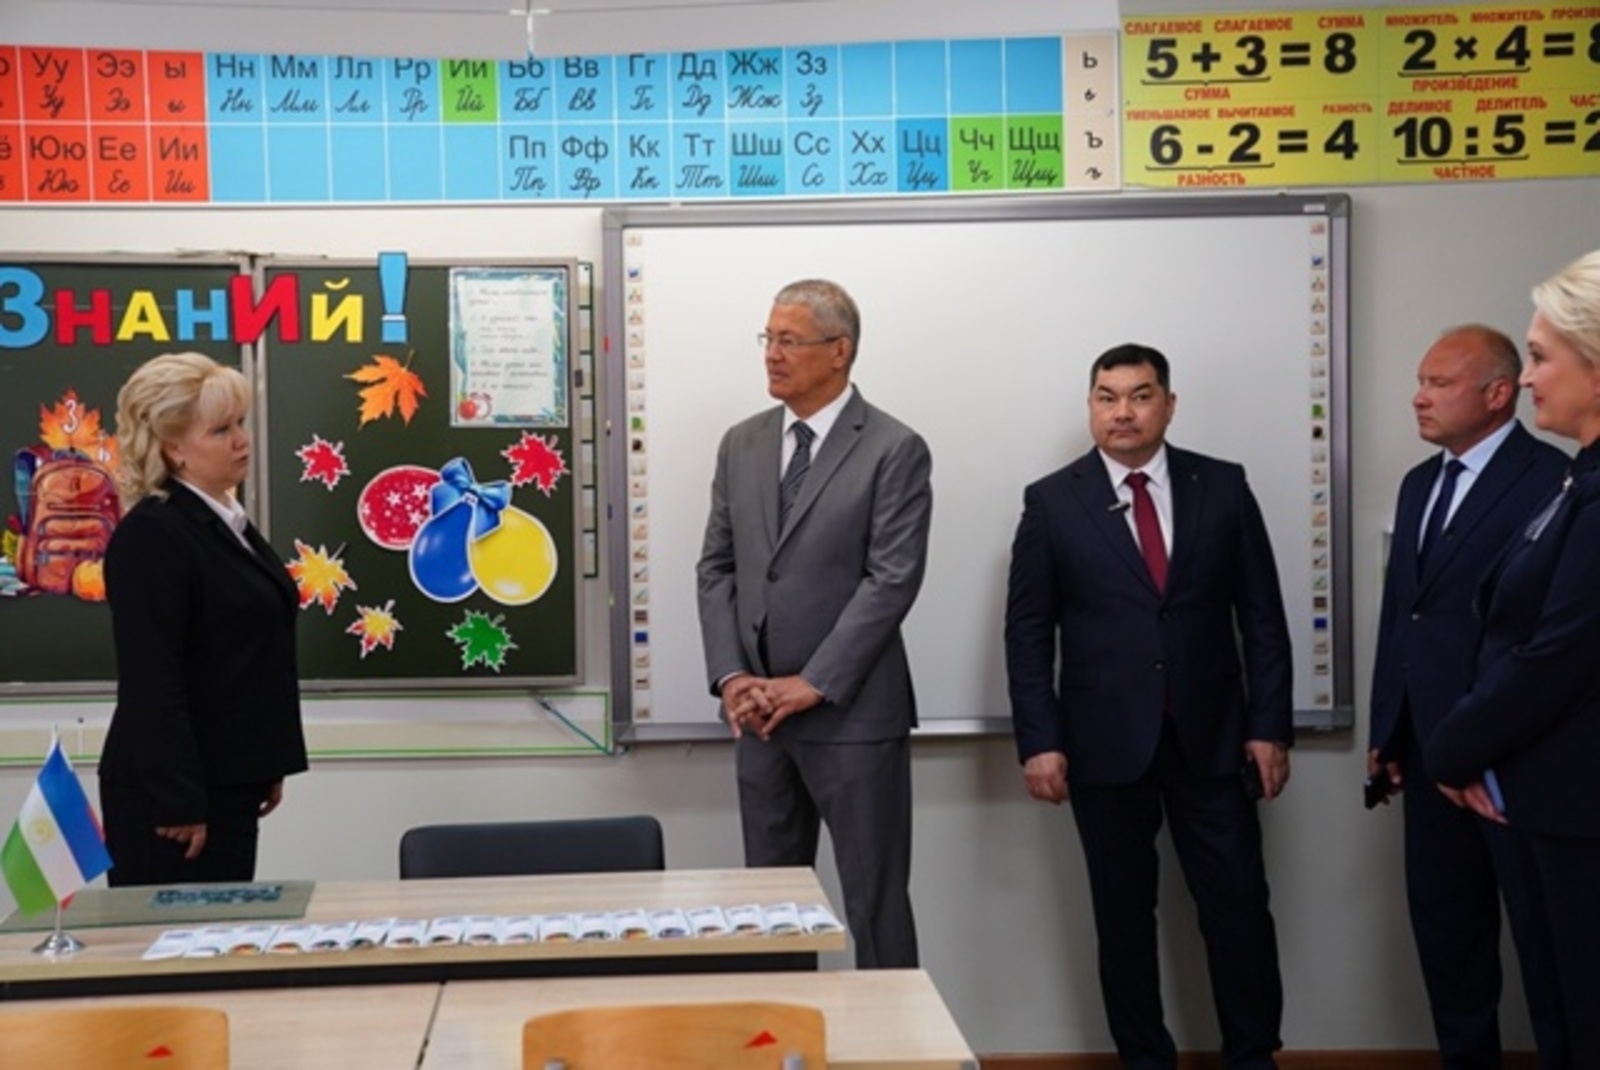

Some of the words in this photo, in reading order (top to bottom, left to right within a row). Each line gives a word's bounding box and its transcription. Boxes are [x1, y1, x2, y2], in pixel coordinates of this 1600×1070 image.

[1125, 20, 1203, 35] СЛАГАЕМОЕ
[1214, 17, 1293, 33] СЛАГАЕМОЕ
[1317, 15, 1365, 29] СУММА
[1386, 13, 1459, 27] МНОЖИТЕЛЬ
[1471, 10, 1545, 23] МНОЖИТЕЛЬ
[1146, 37, 1179, 79] 5
[1234, 35, 1268, 77] 3
[1323, 32, 1357, 74] 8
[1402, 29, 1437, 71] 2
[1495, 24, 1531, 67] 4
[32, 52, 69, 84] Уу
[96, 53, 136, 78] Ээ
[164, 60, 186, 78] ы
[215, 55, 256, 79] Нн
[271, 55, 319, 79] Мм
[677, 53, 717, 81] Дд
[730, 51, 779, 75] Жж
[796, 51, 828, 75] Зз
[1184, 87, 1231, 101] СУММА
[1412, 76, 1519, 92] ПРОИЗВЕДЕНИЕ
[1217, 105, 1296, 119] ВЫЧИТАЕМОЕ
[1322, 103, 1373, 114] РАЗНОСТЬ
[1387, 99, 1453, 116] ДЕЛИМОЕ
[1475, 96, 1548, 113] ДЕЛИТЕЛЬ
[29, 135, 87, 161] Юю
[99, 136, 137, 162] Ее
[159, 136, 200, 162] Ии
[509, 135, 547, 160] Пп
[562, 134, 609, 164] Фф
[628, 134, 659, 159] Кк
[683, 133, 716, 157] Тт
[731, 132, 782, 157] Шш
[902, 130, 941, 158] Цц
[958, 128, 995, 152] Чч
[1008, 127, 1061, 153] Щщ
[1150, 124, 1183, 166] 6
[1228, 122, 1261, 163] 2
[1324, 119, 1359, 161] 4
[1393, 116, 1453, 158] 10
[1492, 114, 1526, 155] 5
[1177, 172, 1246, 186] РАЗНОСТЬ
[1433, 165, 1496, 179] ЧАСТНОЕ
